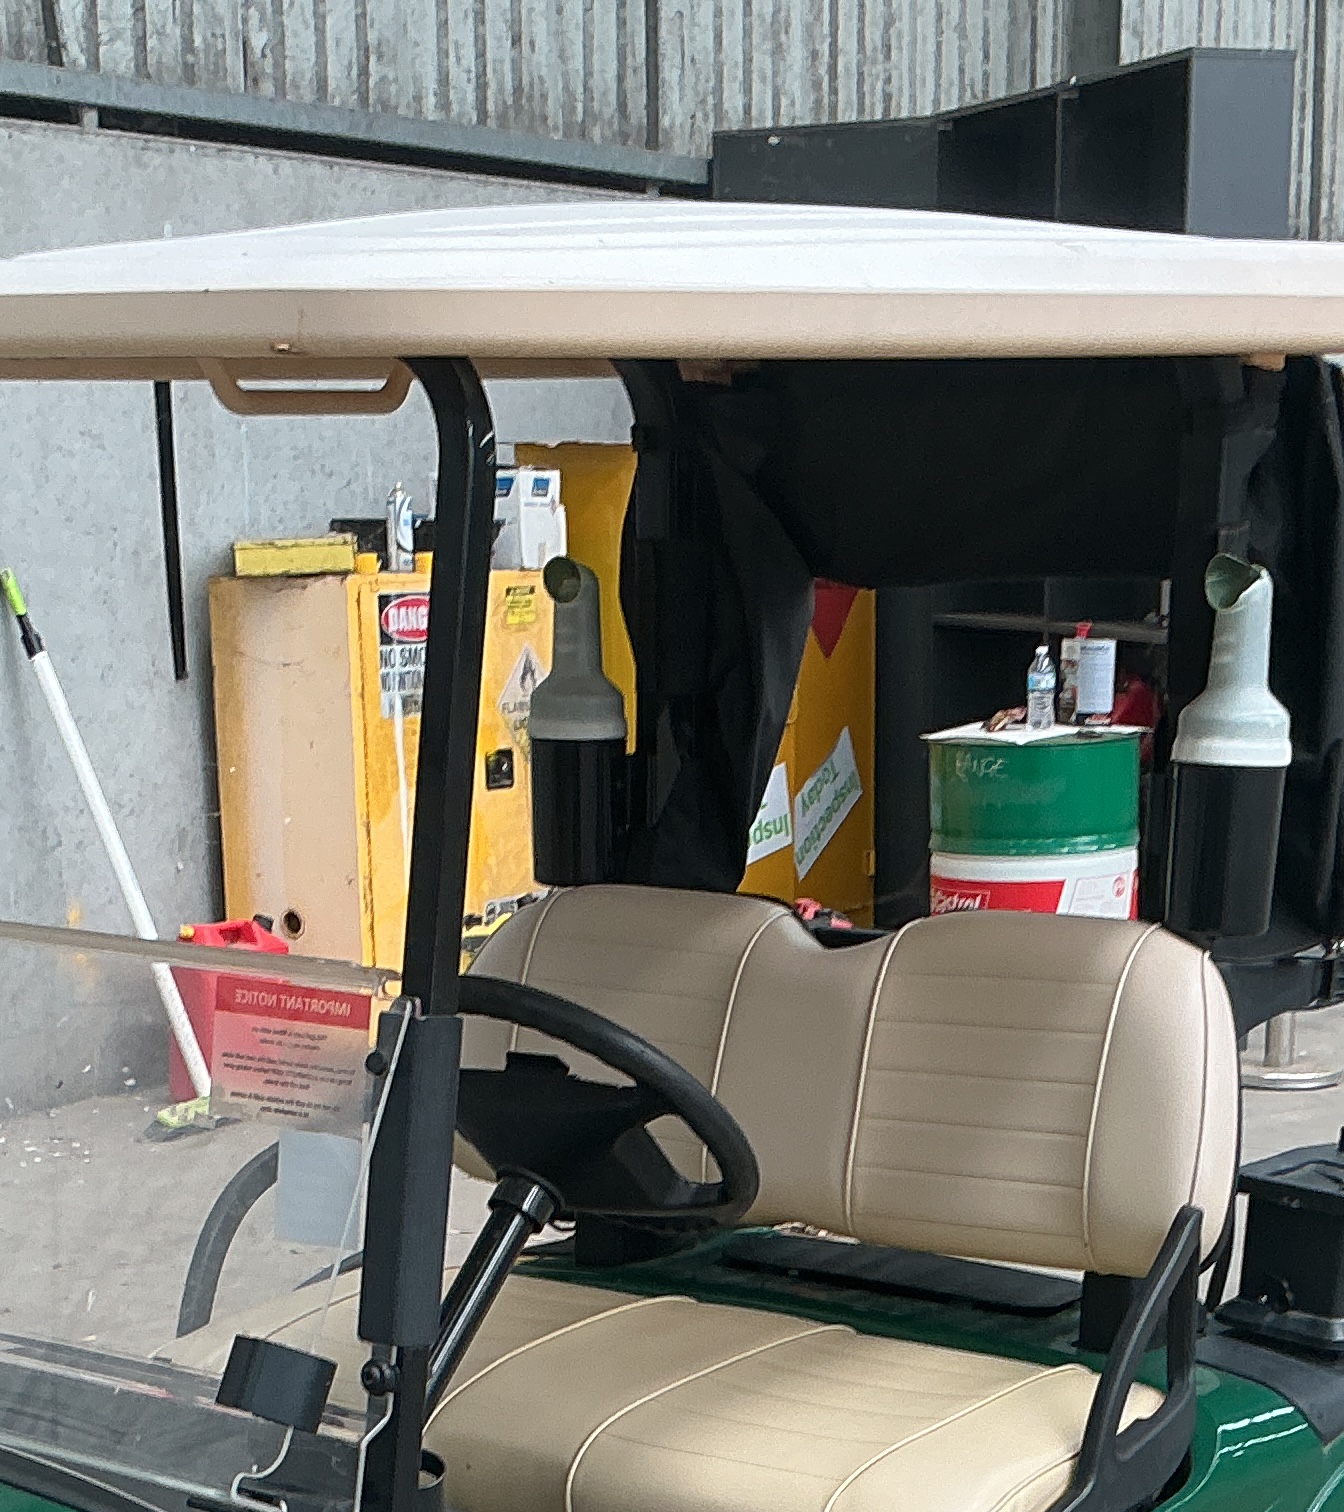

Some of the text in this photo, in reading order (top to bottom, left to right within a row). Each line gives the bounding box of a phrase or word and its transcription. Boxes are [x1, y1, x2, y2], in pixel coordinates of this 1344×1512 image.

[388, 604, 428, 632] DANG
[800, 758, 840, 817] Today
[748, 812, 789, 845] Insp
[795, 770, 860, 866] Inspection
